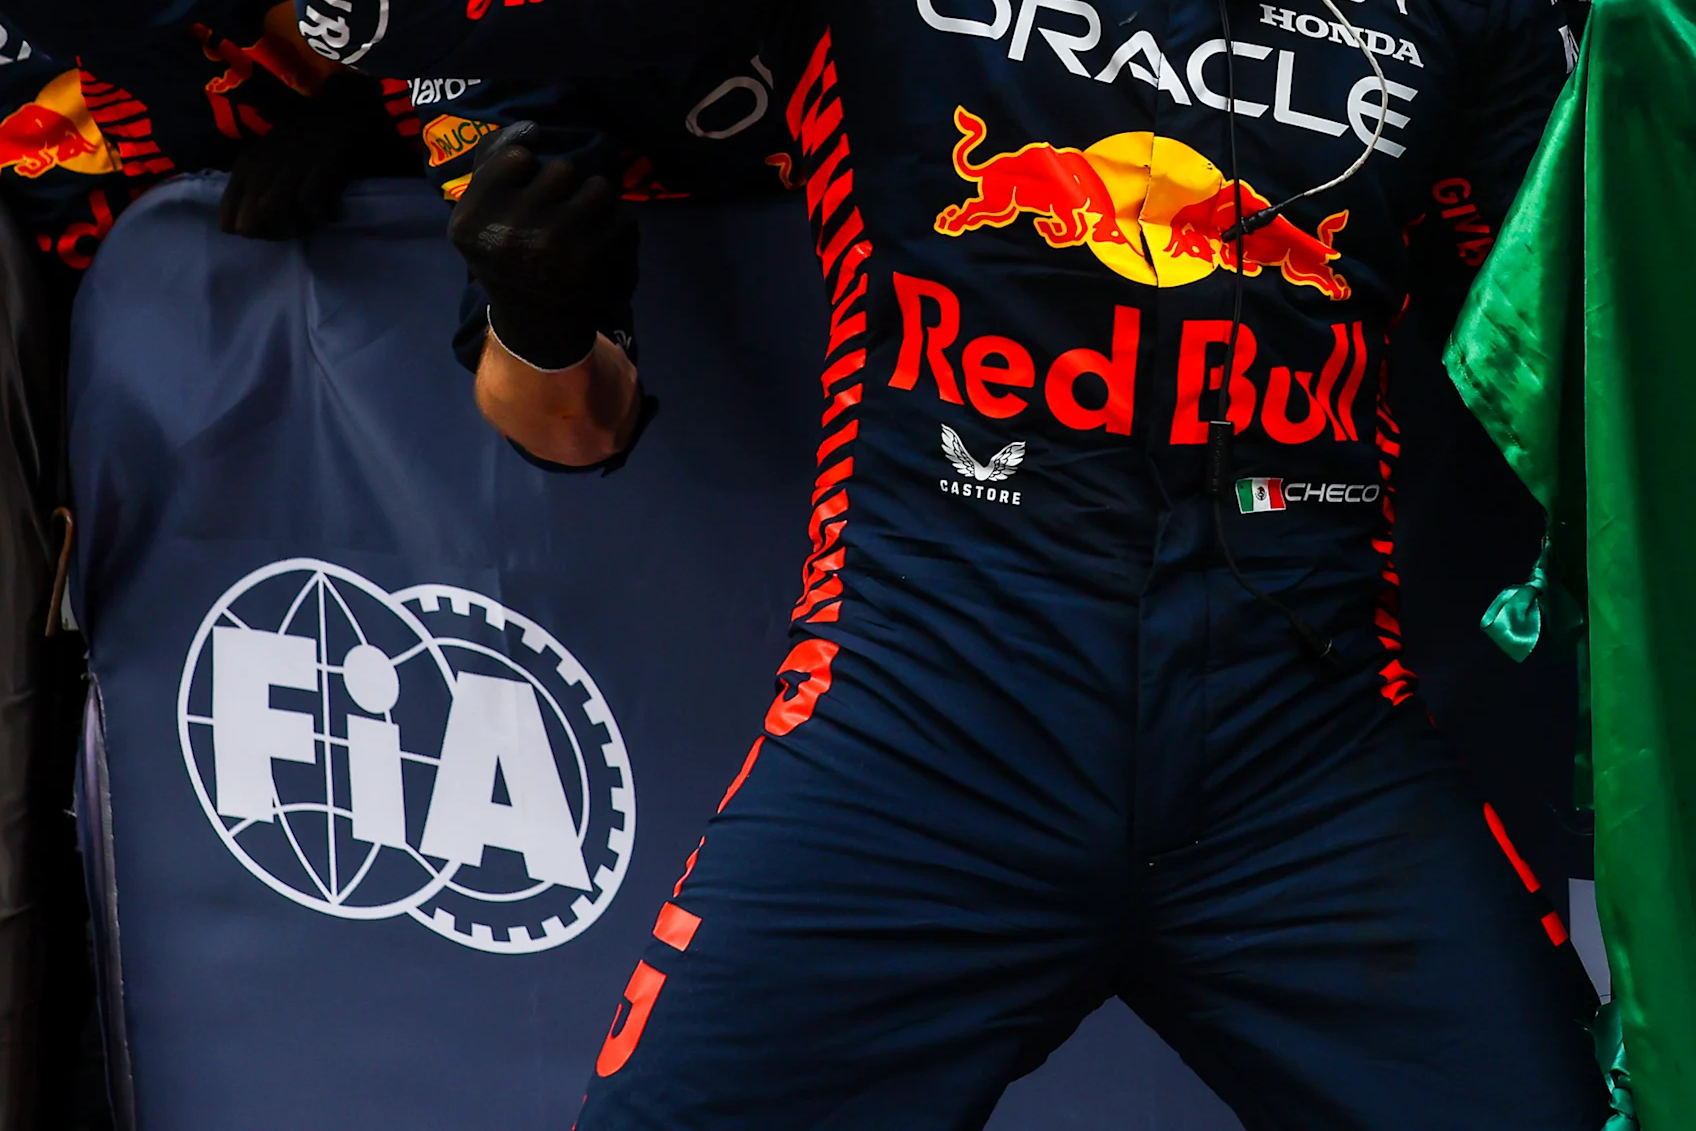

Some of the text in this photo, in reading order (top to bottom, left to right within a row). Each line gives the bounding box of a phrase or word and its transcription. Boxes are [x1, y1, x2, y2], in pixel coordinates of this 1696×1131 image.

[299, 5, 351, 61] Ro
[1259, 3, 1425, 69] HONDA
[887, 271, 1368, 446] Red Bull
[939, 479, 1023, 506] CASTORE
[1284, 480, 1382, 504] CHECO
